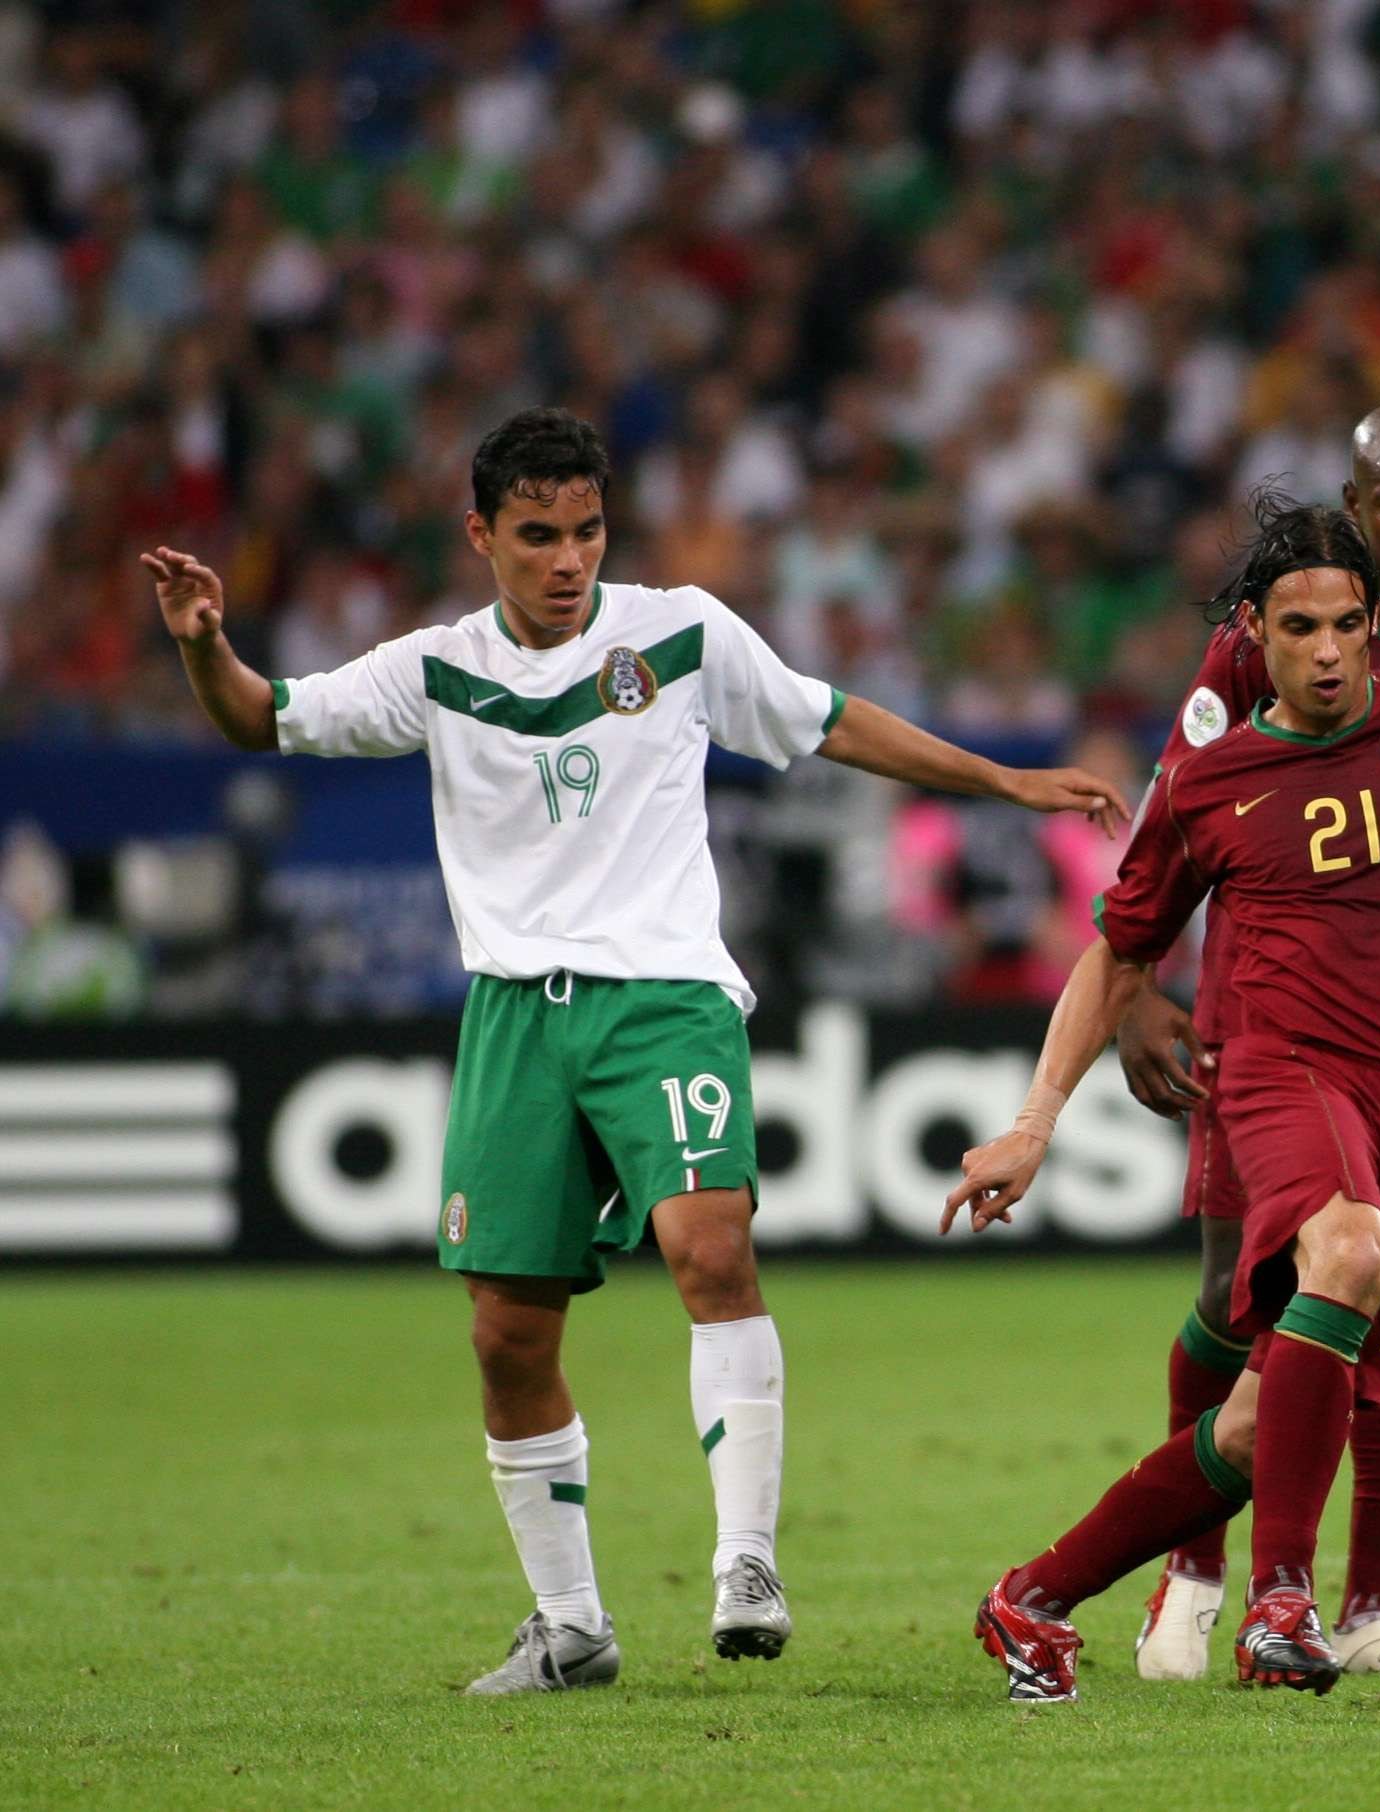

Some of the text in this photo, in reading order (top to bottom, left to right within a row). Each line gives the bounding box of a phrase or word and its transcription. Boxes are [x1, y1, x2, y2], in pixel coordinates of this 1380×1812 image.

[532, 744, 600, 824] 19
[1304, 788, 1380, 873] 21
[660, 1072, 731, 1142] 19
